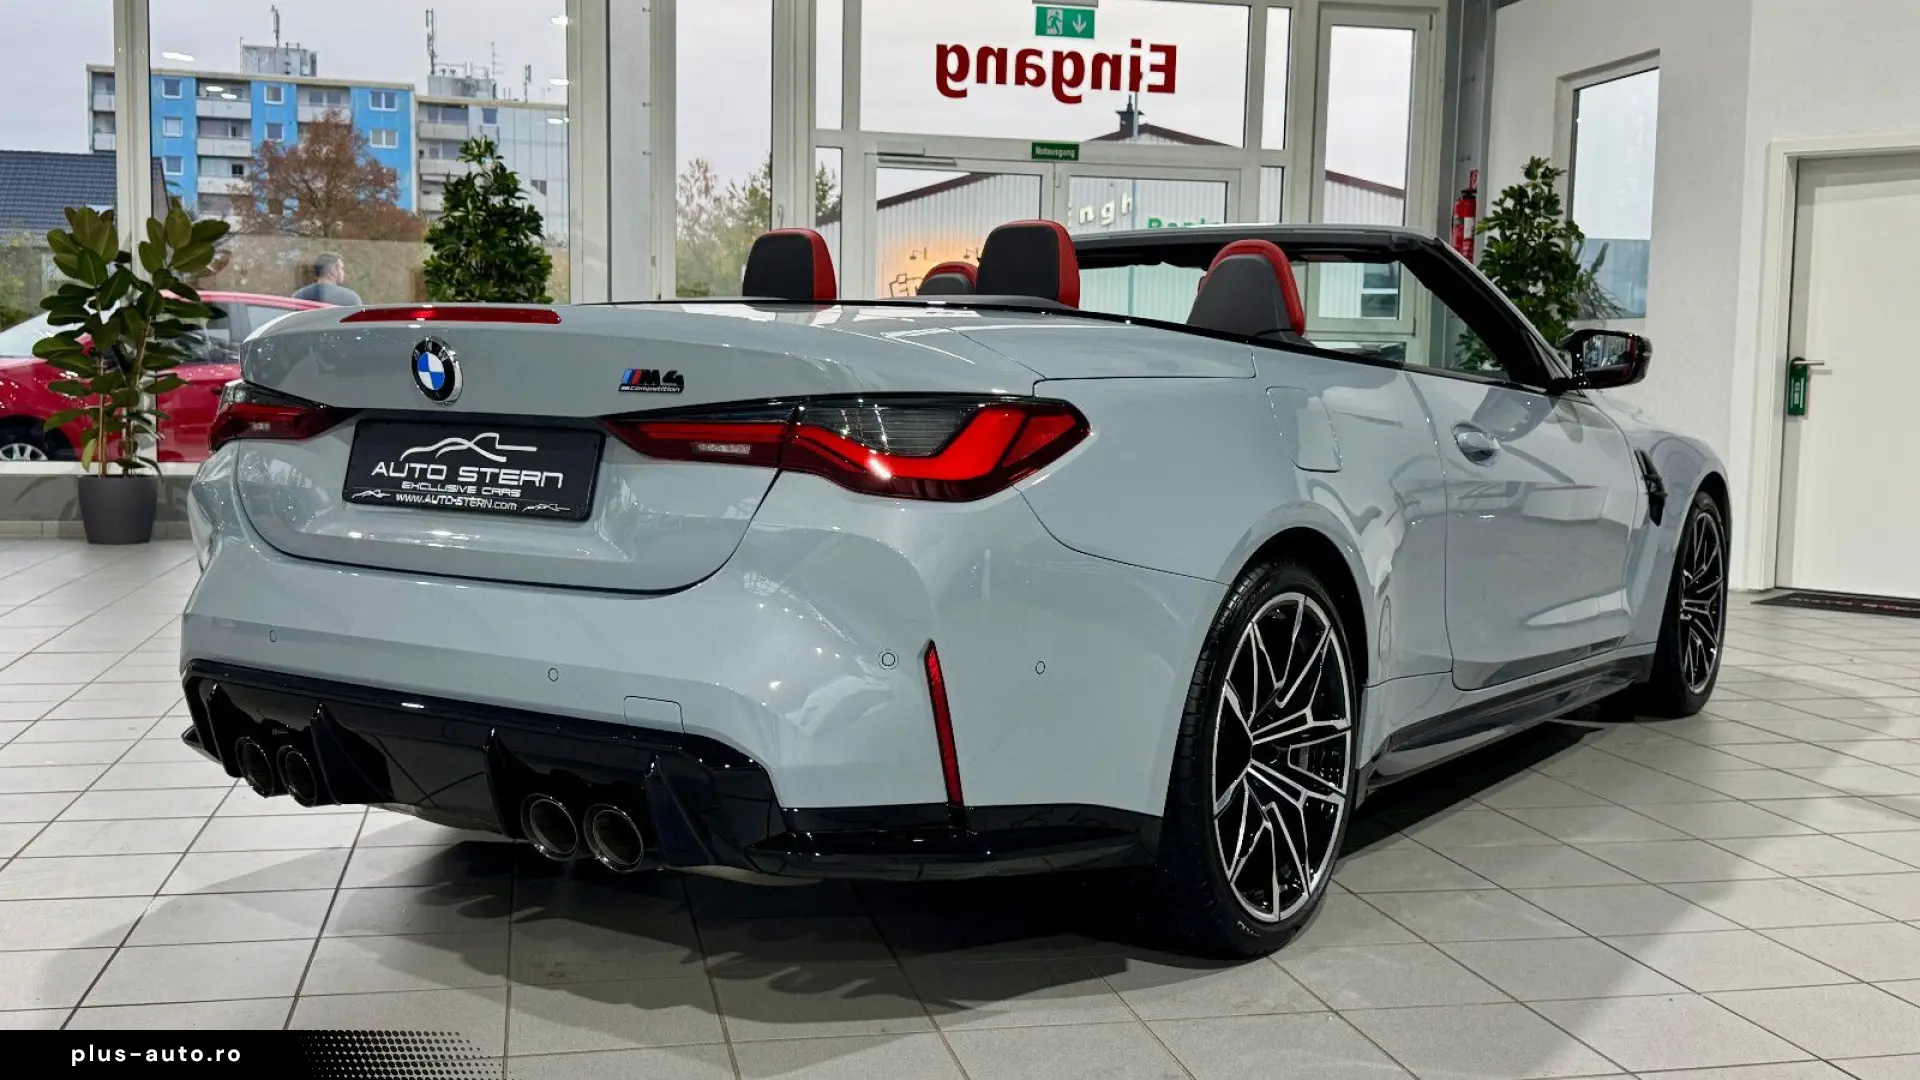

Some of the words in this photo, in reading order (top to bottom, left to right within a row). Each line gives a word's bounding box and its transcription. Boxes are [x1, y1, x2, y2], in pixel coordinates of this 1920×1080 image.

[1035, 146, 1075, 158] Notausgang
[371, 461, 447, 480] AUTO
[457, 466, 563, 489] STERN
[401, 481, 477, 494] EXCLUSIVE
[481, 486, 521, 498] CARS
[395, 492, 517, 512] www.AUTO-STERN.com
